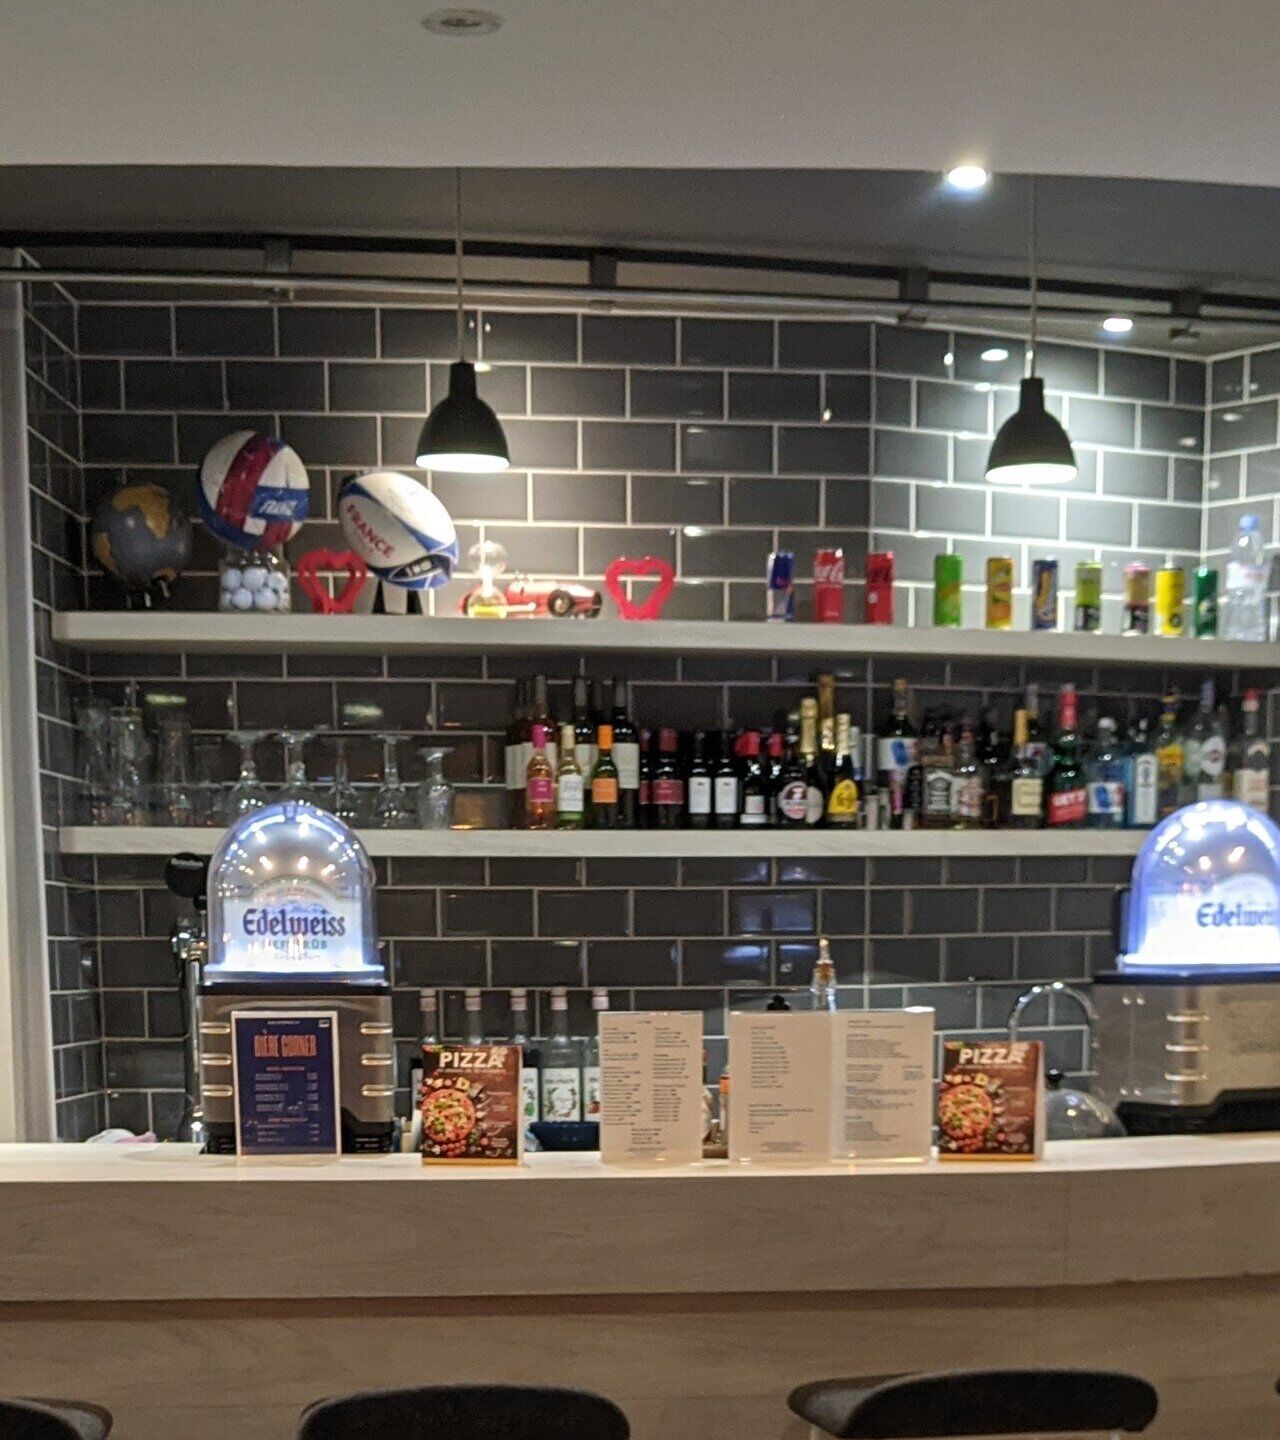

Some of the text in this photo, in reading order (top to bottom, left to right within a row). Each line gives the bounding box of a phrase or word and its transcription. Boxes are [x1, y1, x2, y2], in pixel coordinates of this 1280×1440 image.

[346, 502, 396, 558] FRANCE
[242, 908, 346, 937] Edelweiss
[439, 1051, 504, 1068] PIZZA
[958, 1048, 1024, 1065] PIZZA
